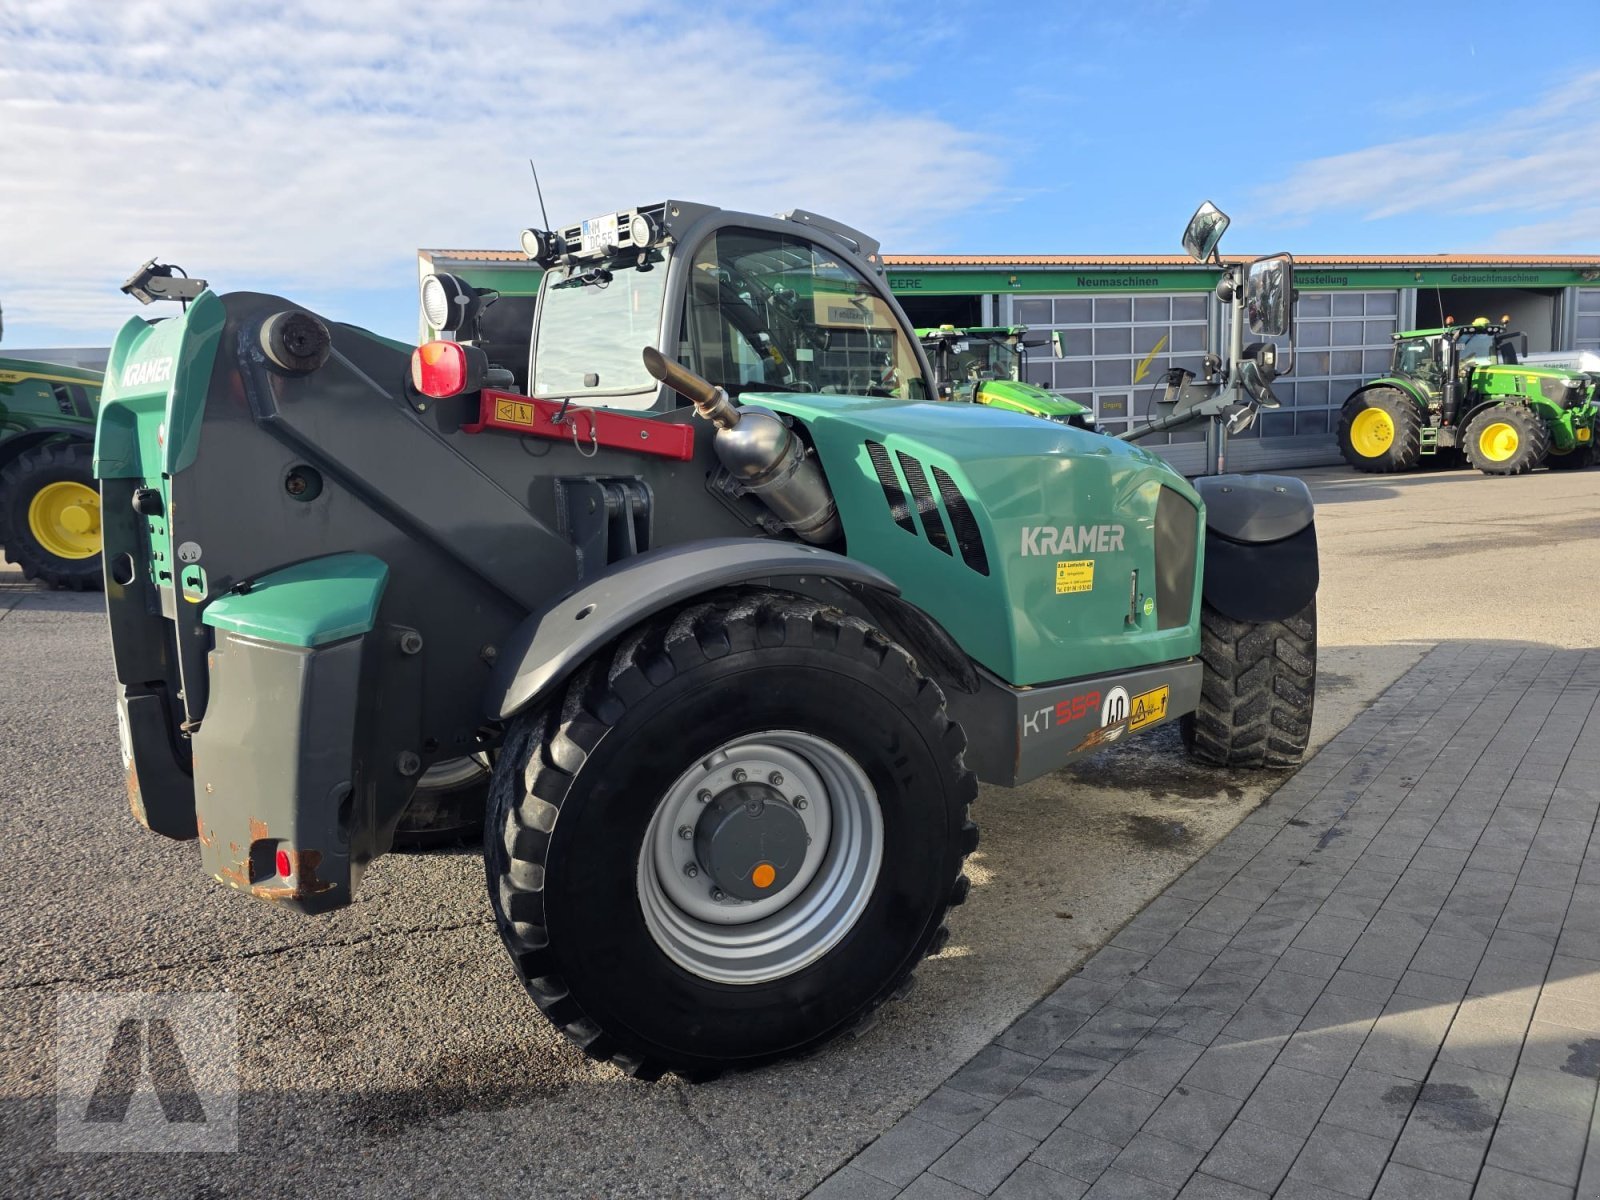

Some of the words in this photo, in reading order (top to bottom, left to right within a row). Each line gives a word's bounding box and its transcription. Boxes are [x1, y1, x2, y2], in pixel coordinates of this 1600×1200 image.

[1077, 277, 1158, 287] Neumaschinen
[1293, 275, 1348, 286] Ausstellung
[1451, 273, 1539, 283] Gebrauchtmaschinen
[888, 279, 922, 289] EERE
[122, 357, 173, 387] KRAMER
[1021, 525, 1125, 557] KRAMER
